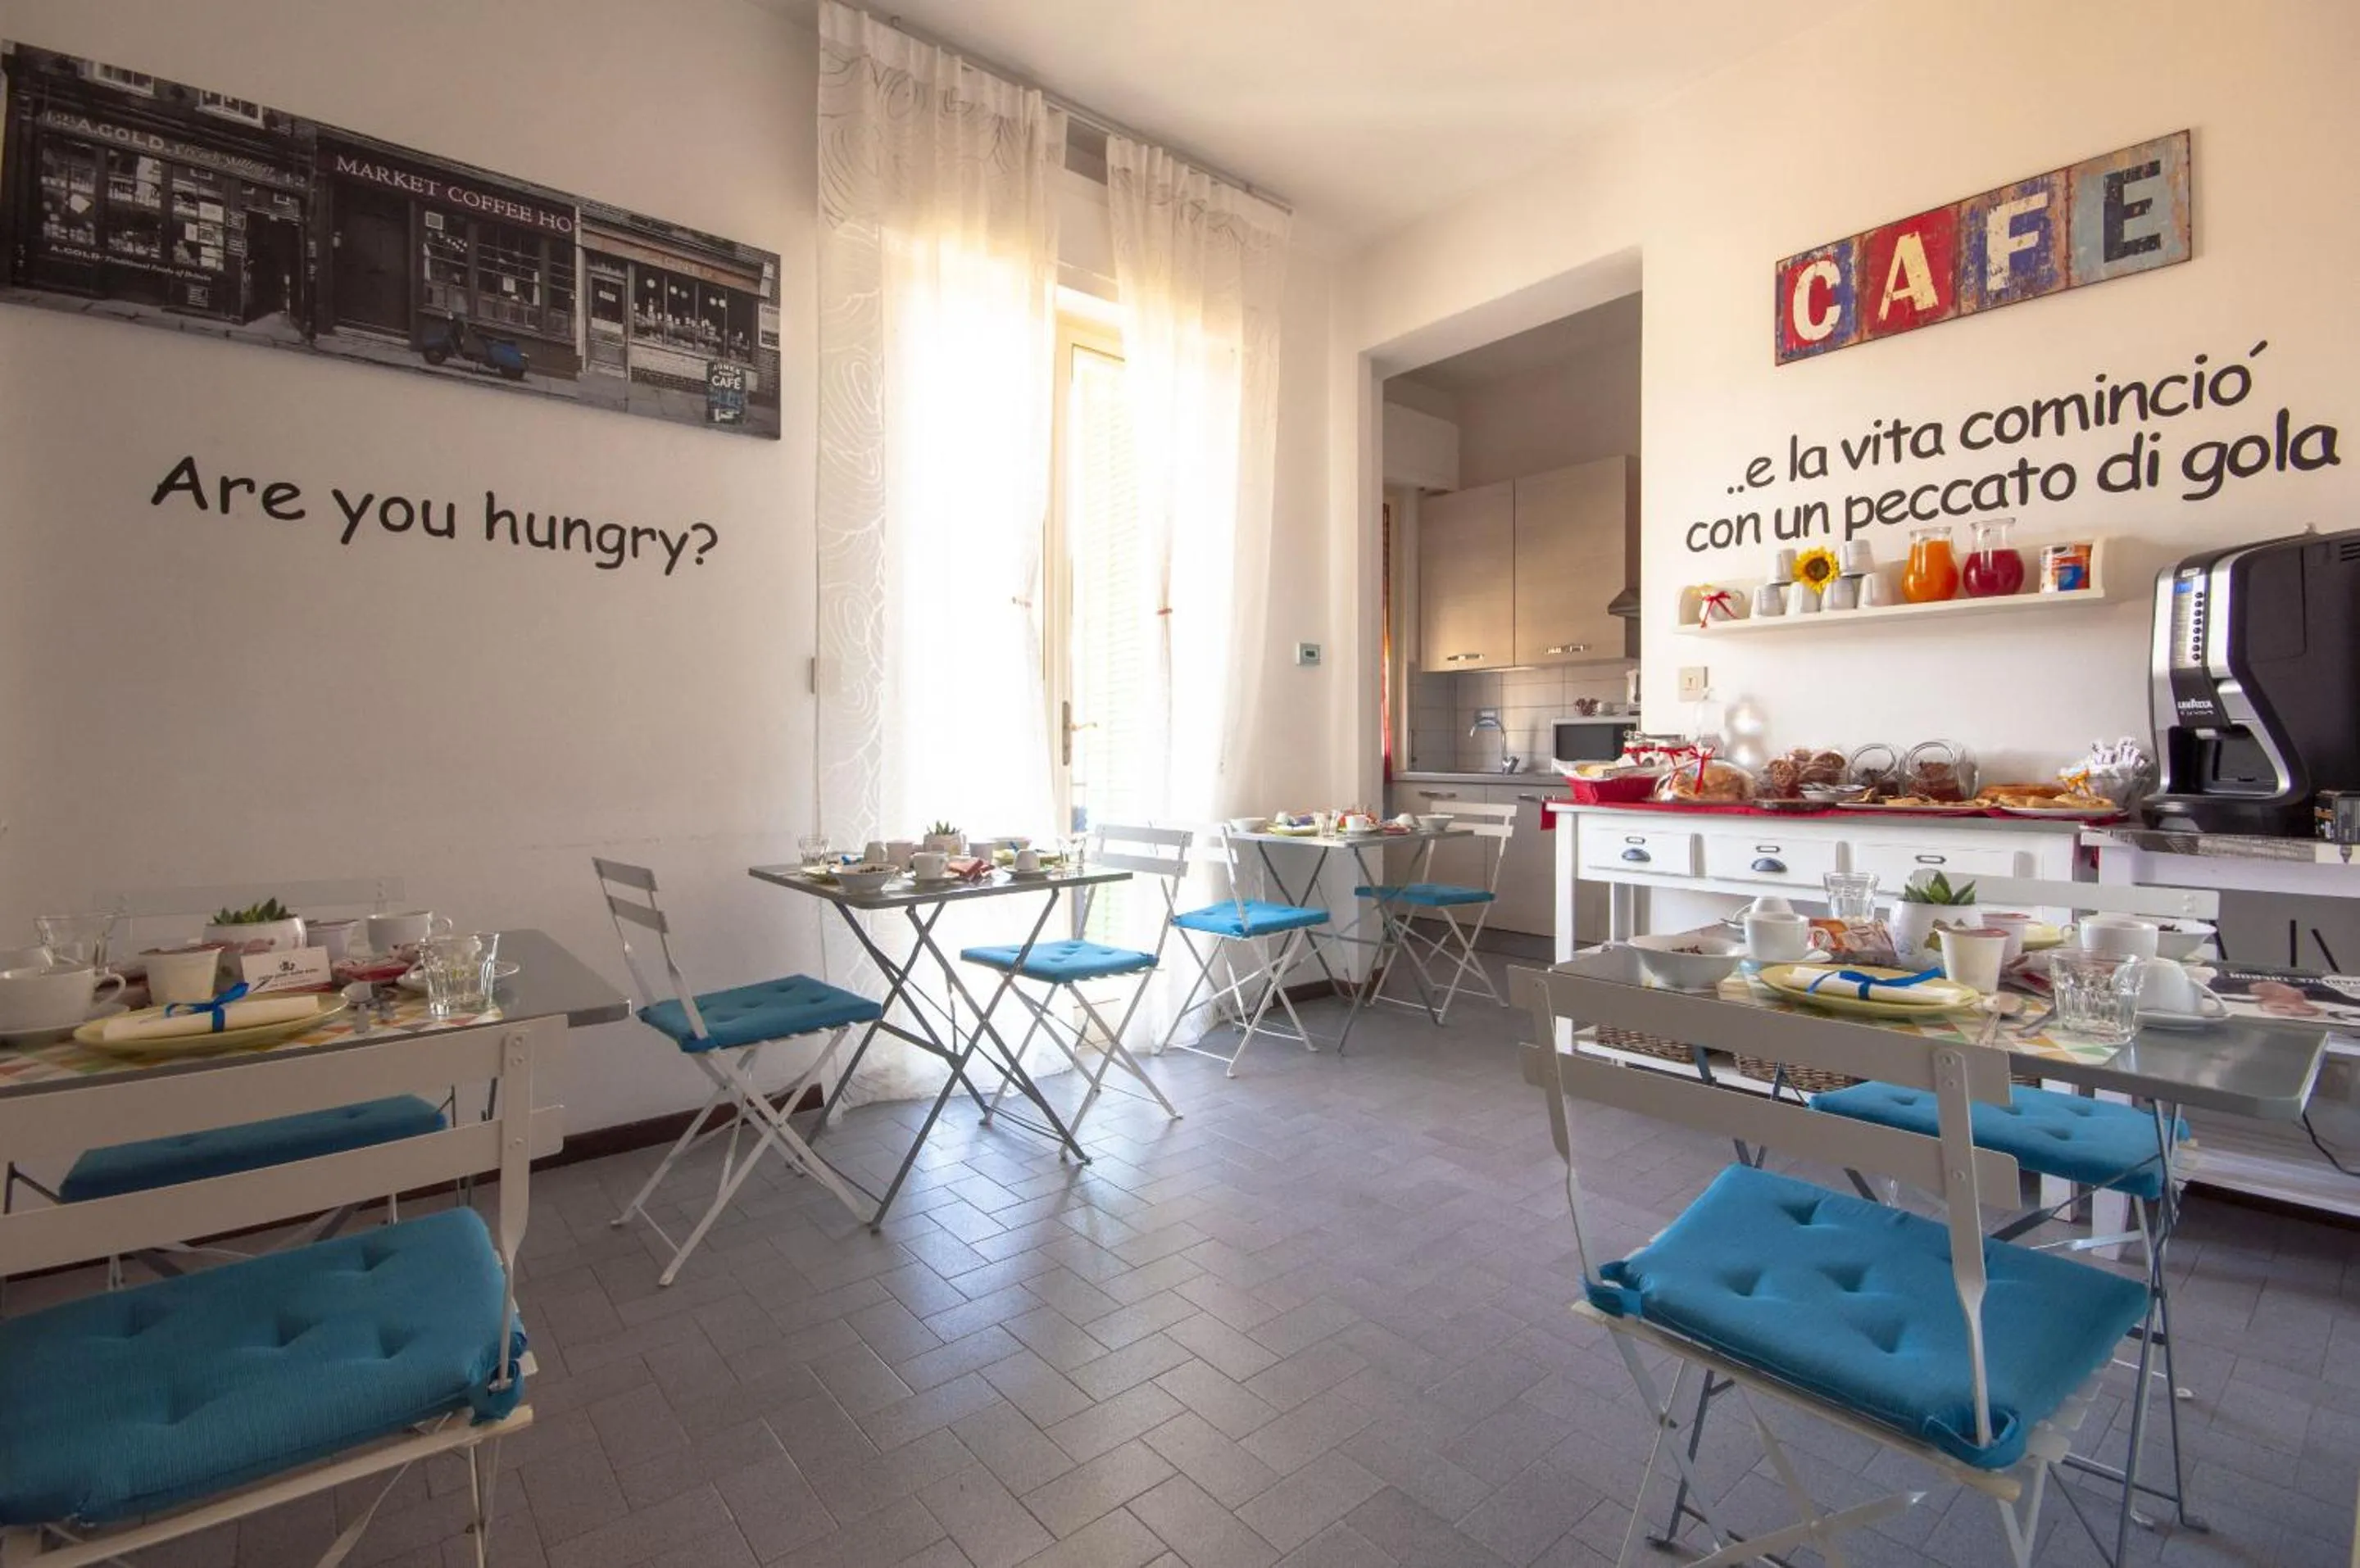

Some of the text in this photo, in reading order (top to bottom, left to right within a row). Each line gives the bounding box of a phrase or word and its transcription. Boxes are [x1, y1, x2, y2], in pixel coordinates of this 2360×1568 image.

[336, 155, 573, 233] MARKET COFFEE HO
[1792, 160, 2162, 341] CAFE
[1686, 406, 2342, 553] con un peccato di gola
[1789, 433, 1829, 483] la
[1840, 418, 1946, 471] vita
[150, 455, 719, 577] Are you hungry?
